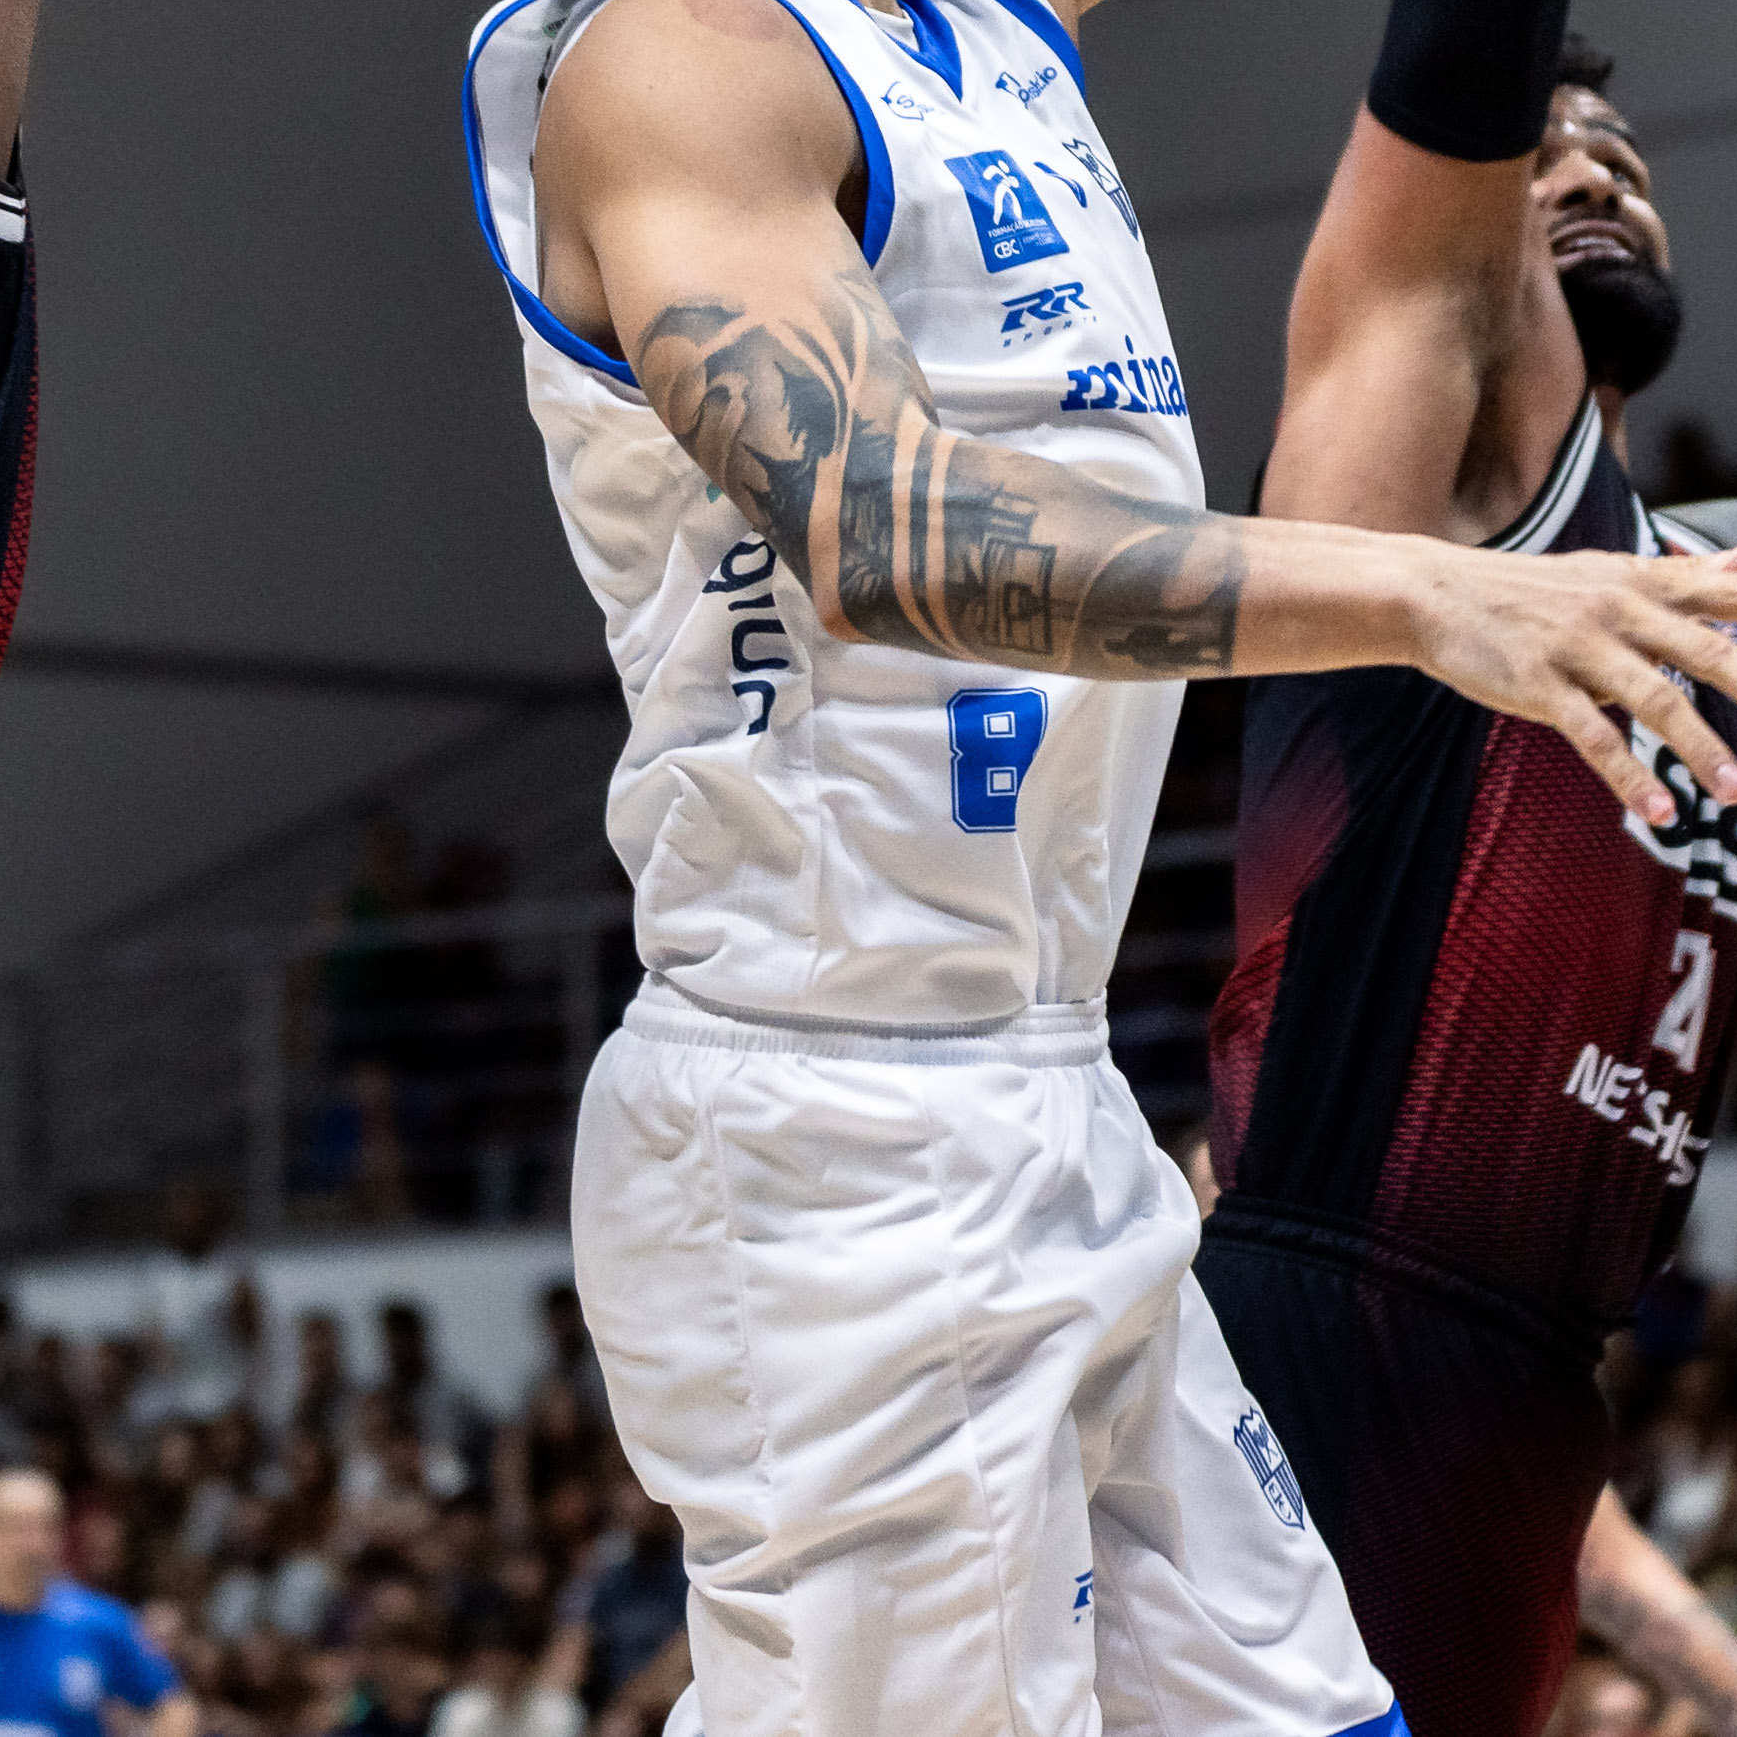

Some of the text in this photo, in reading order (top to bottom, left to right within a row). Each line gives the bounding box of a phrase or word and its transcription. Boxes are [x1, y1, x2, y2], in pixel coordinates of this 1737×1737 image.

[993, 238, 1020, 259] CBC
[1001, 281, 1092, 334] RR
[949, 688, 1047, 834] 8
